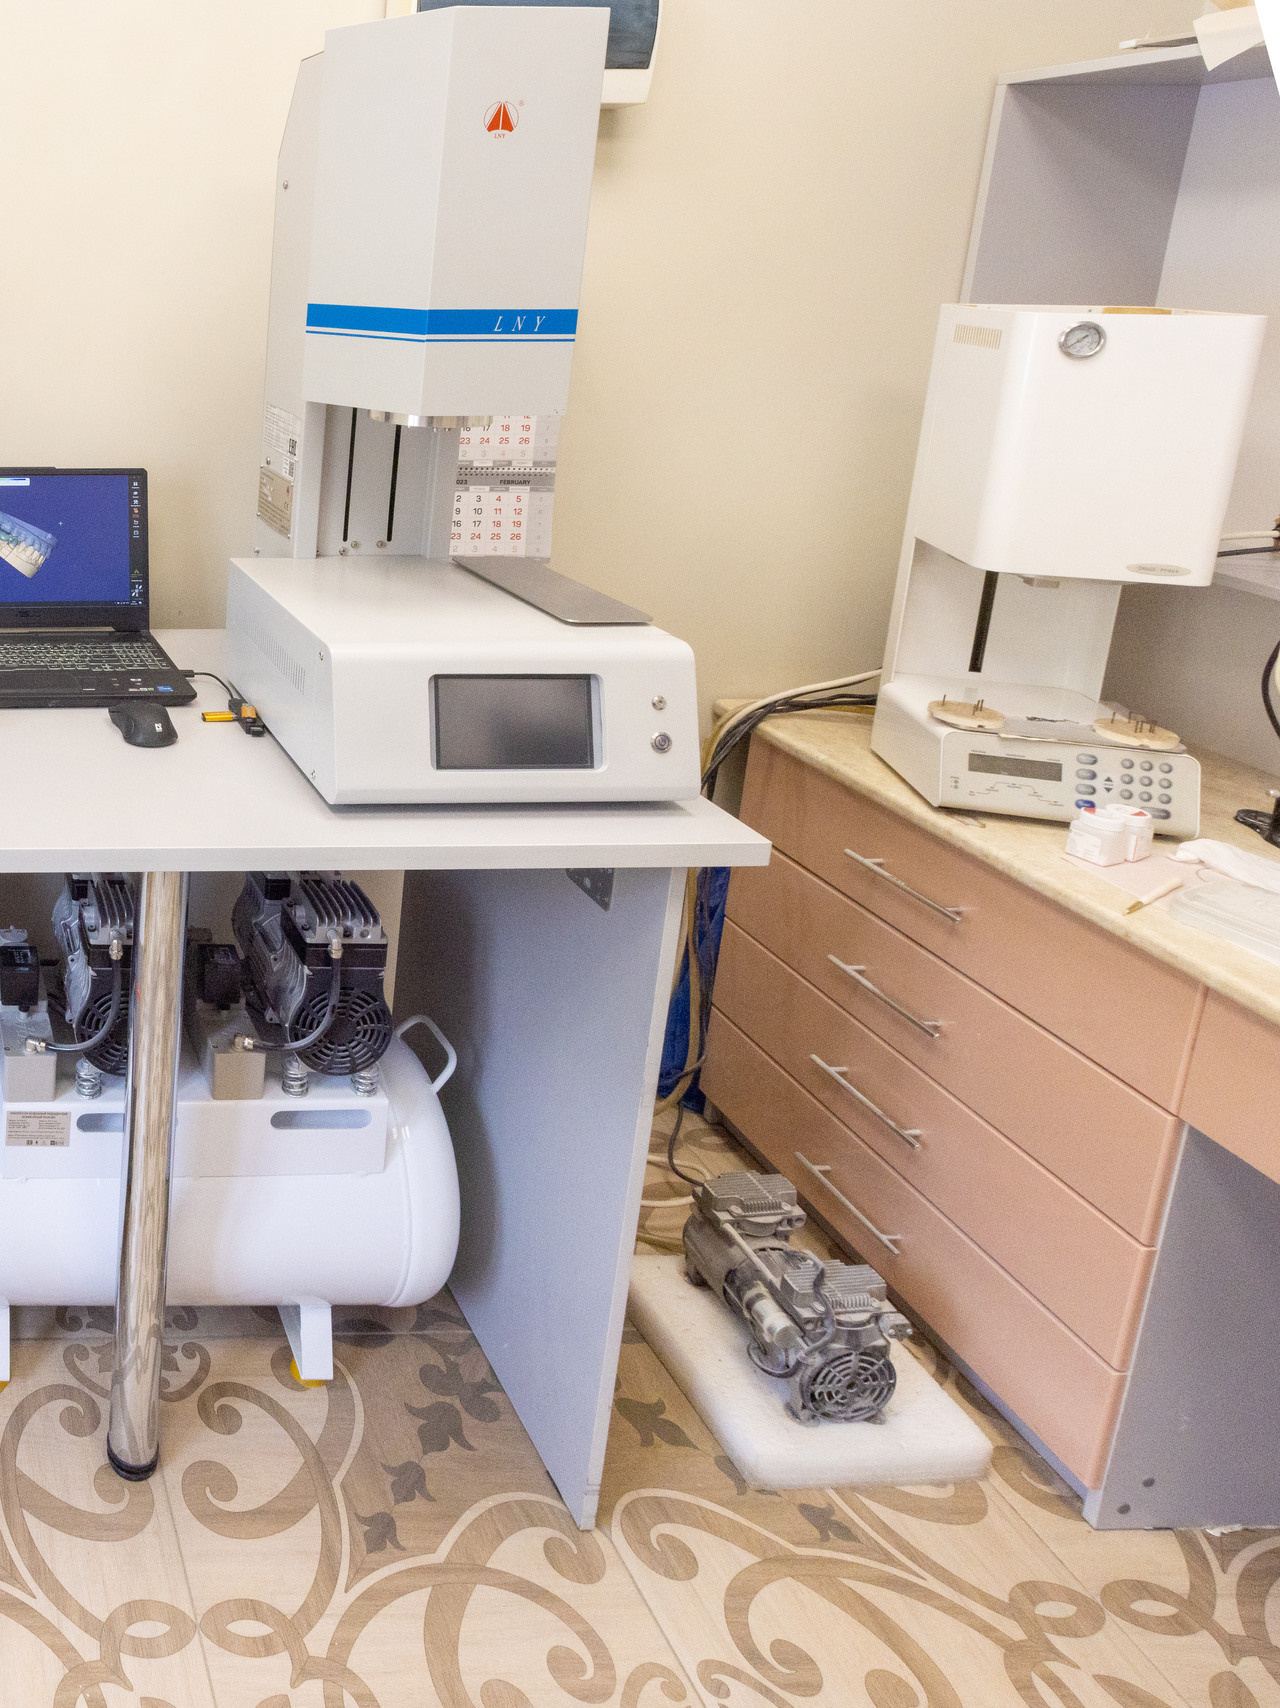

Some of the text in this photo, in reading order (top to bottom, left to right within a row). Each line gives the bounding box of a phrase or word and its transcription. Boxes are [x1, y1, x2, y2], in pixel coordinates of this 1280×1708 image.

[493, 316, 546, 332] LNY
[501, 424, 510, 432] 18
[521, 424, 531, 432] 19
[460, 437, 471, 445] 23
[479, 437, 490, 445] 24
[499, 437, 510, 445] 25
[519, 437, 530, 445] 26
[456, 495, 462, 503] 2
[476, 495, 482, 503] 3
[516, 495, 521, 503] 5
[455, 507, 461, 515] 9
[452, 520, 462, 528] 16
[472, 520, 482, 528] 17
[492, 520, 501, 528] 18
[512, 520, 521, 528] 19
[450, 533, 461, 541] 23
[510, 533, 521, 541] 26
[512, 545, 517, 553] 5
